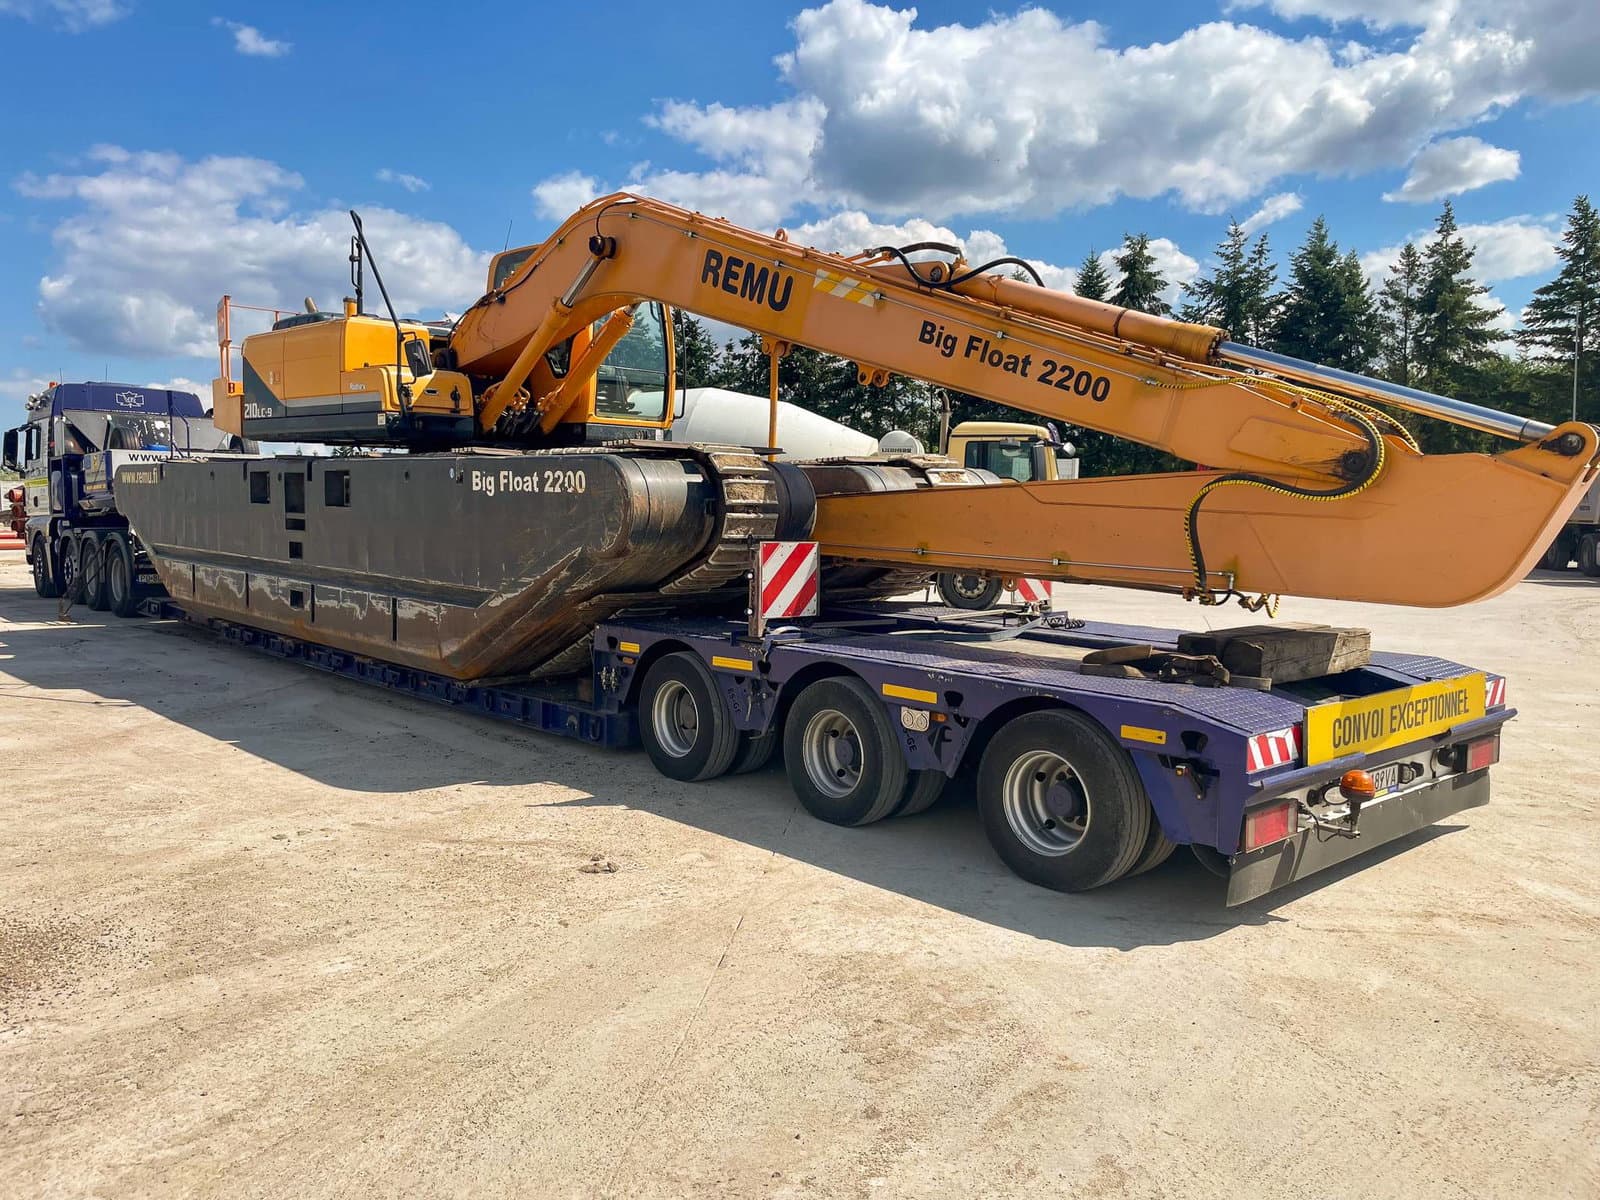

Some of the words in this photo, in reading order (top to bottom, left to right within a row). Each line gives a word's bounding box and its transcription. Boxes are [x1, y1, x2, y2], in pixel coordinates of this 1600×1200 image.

[701, 249, 794, 311] REMU
[918, 320, 958, 358] Big
[964, 335, 1032, 378] Float
[1037, 359, 1111, 402] 2200
[471, 470, 495, 497] Big
[499, 470, 539, 493] Float
[543, 470, 586, 493] 2200
[1332, 707, 1384, 749] CONVOI
[1389, 688, 1469, 733] EXCEPTIONNEL
